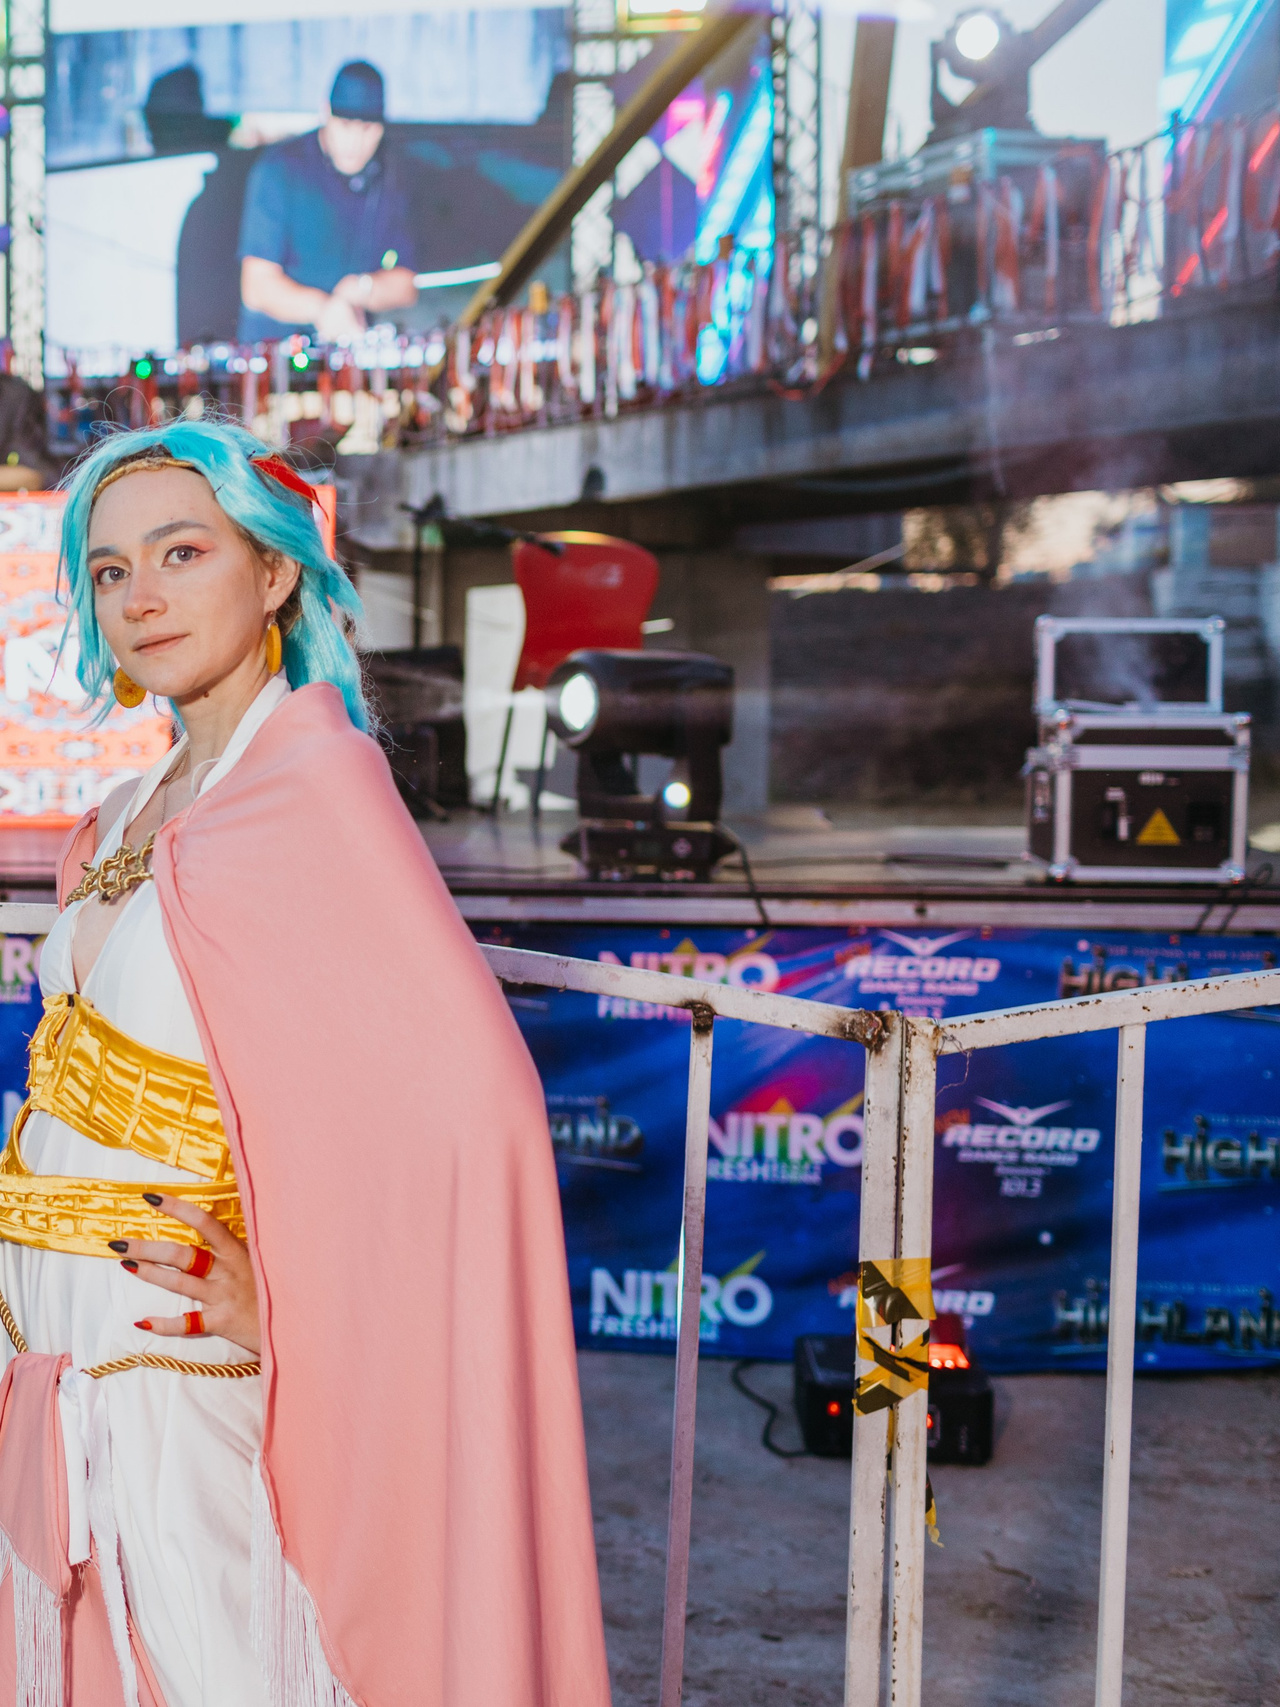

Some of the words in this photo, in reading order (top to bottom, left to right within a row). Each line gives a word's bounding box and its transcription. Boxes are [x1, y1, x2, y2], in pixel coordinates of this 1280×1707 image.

[598, 951, 780, 993] TRO
[844, 954, 1002, 983] RECORD
[941, 1123, 1102, 1153] RECORD
[1162, 1113, 1280, 1181] HIGH
